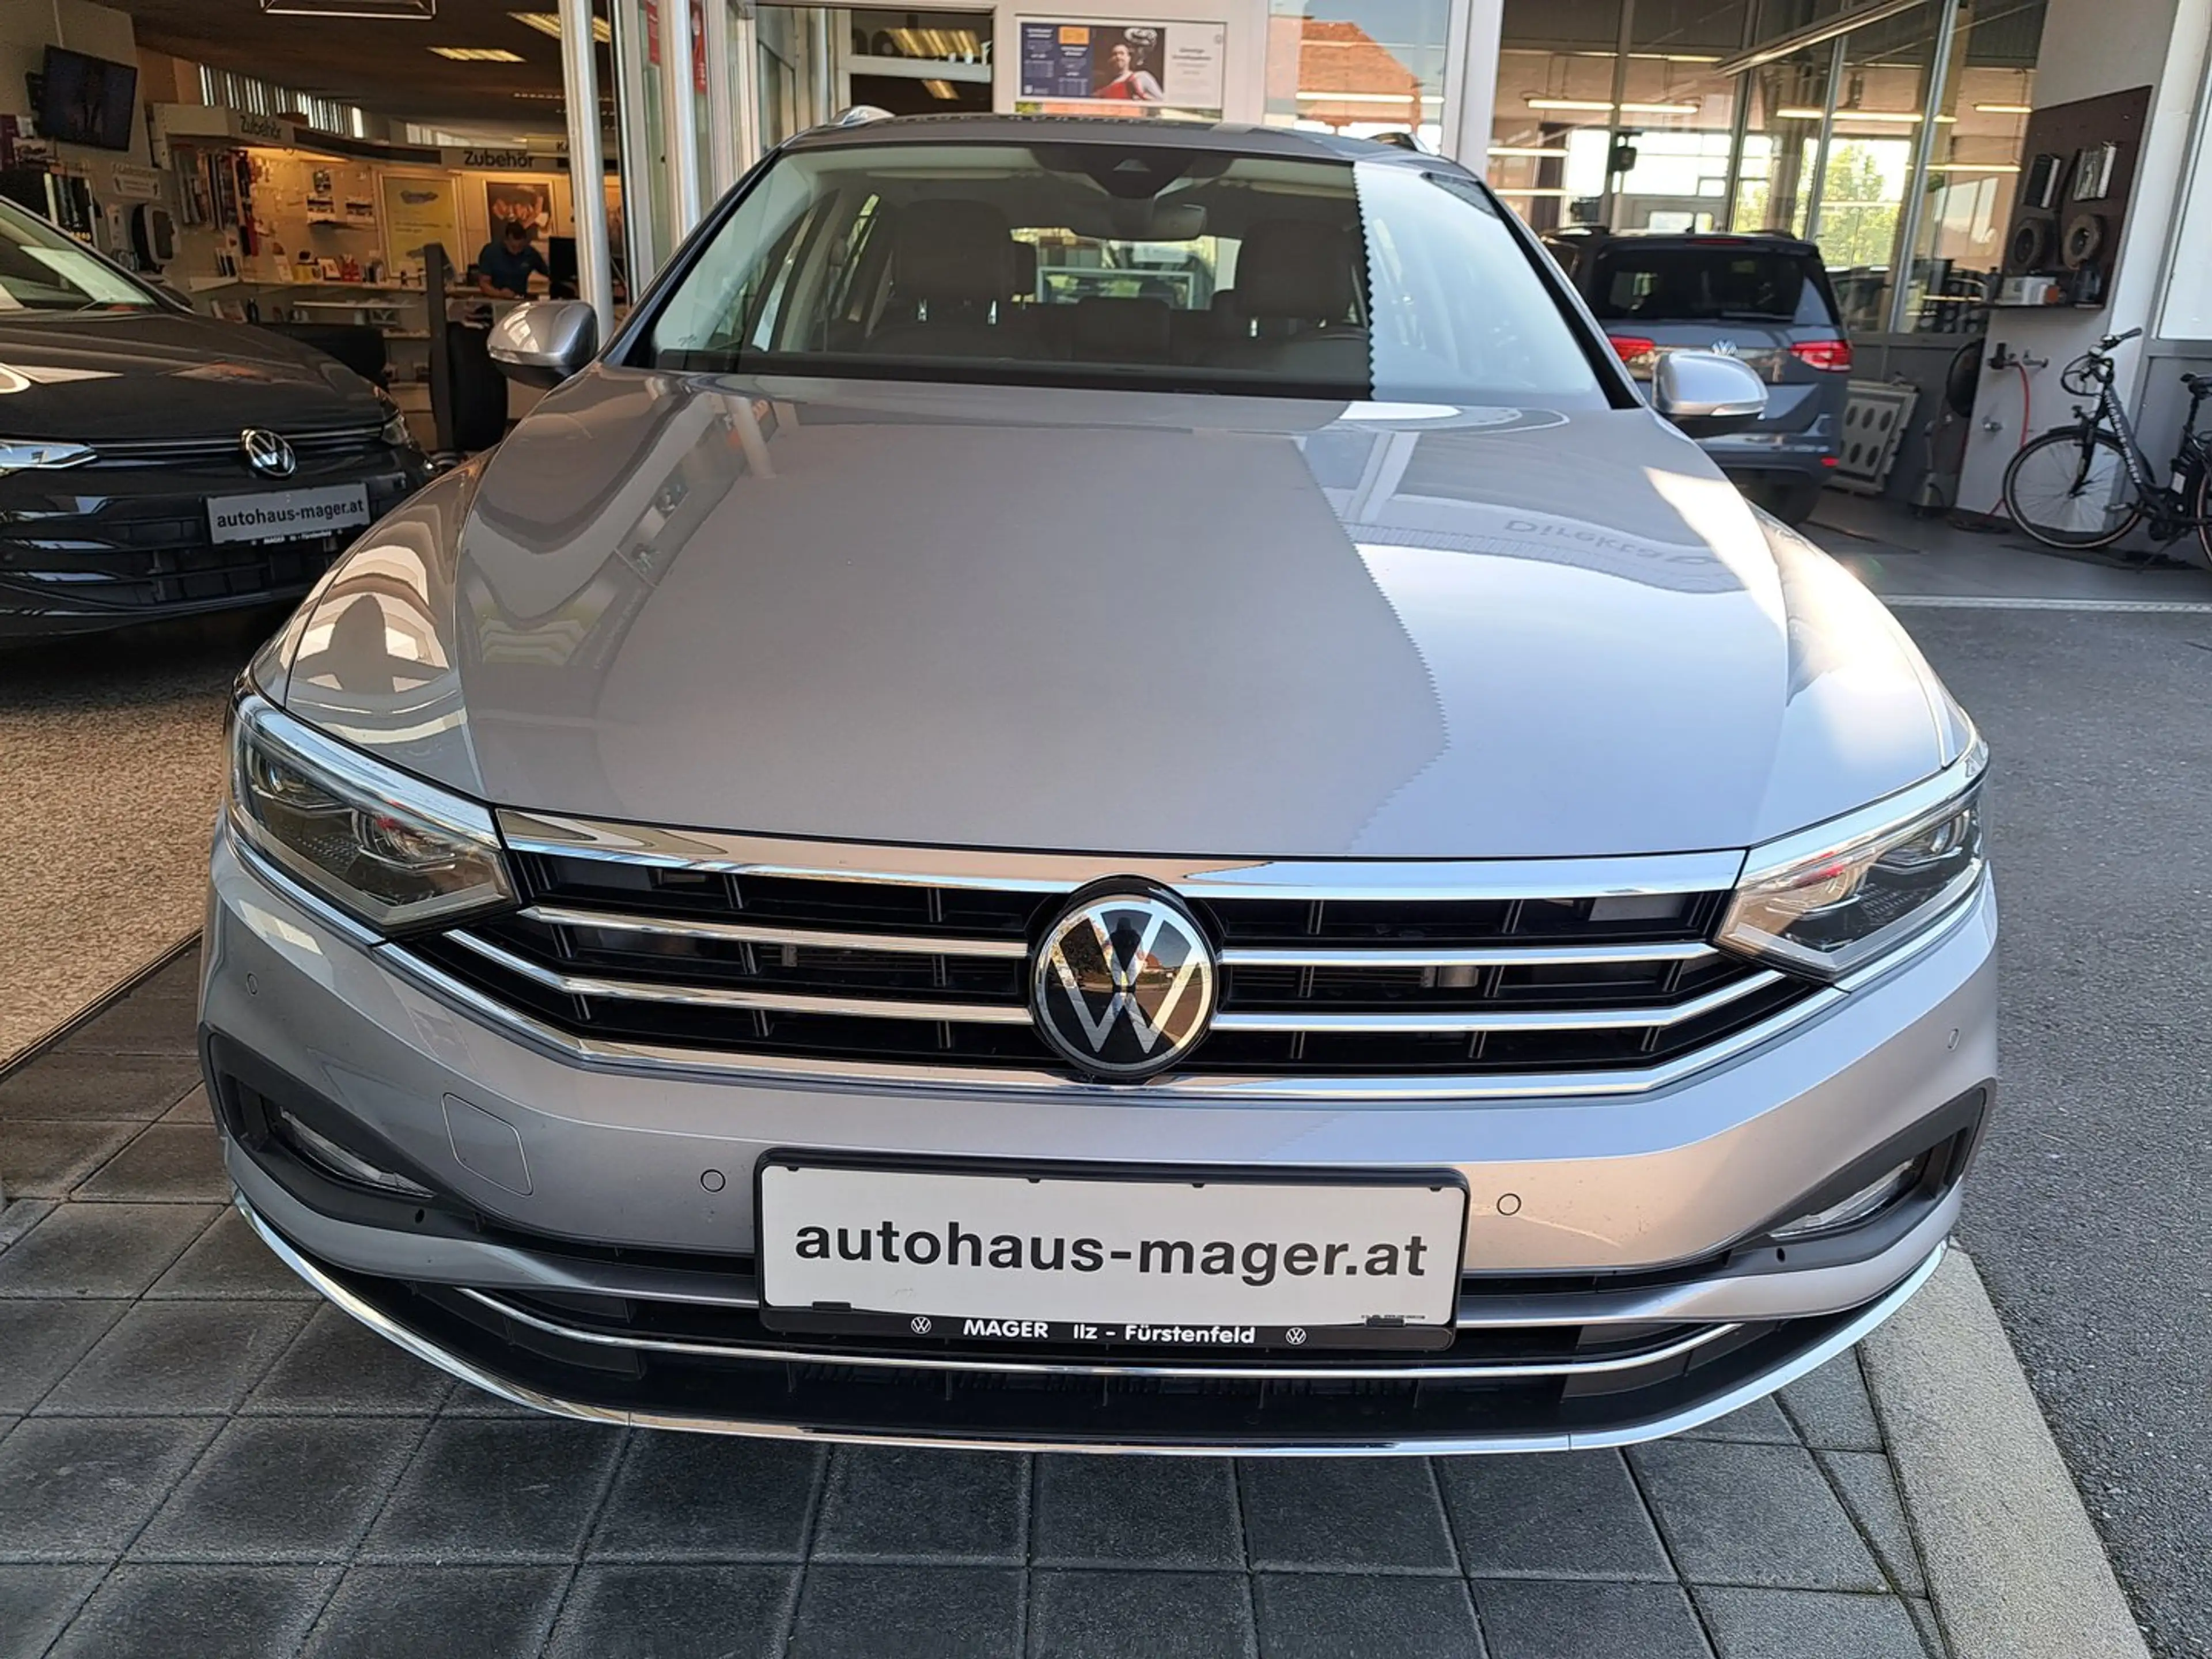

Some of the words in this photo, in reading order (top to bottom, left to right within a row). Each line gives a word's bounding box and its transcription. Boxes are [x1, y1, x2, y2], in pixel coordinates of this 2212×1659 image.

[464, 149, 535, 168] Zubehör
[217, 499, 364, 528] autohaus-mager.at
[795, 1220, 1428, 1286] autohaus-mager.at
[963, 1319, 1049, 1339] MAGER
[1073, 1324, 1098, 1339] Ilz
[1124, 1324, 1256, 1344] Fürstenfeld
